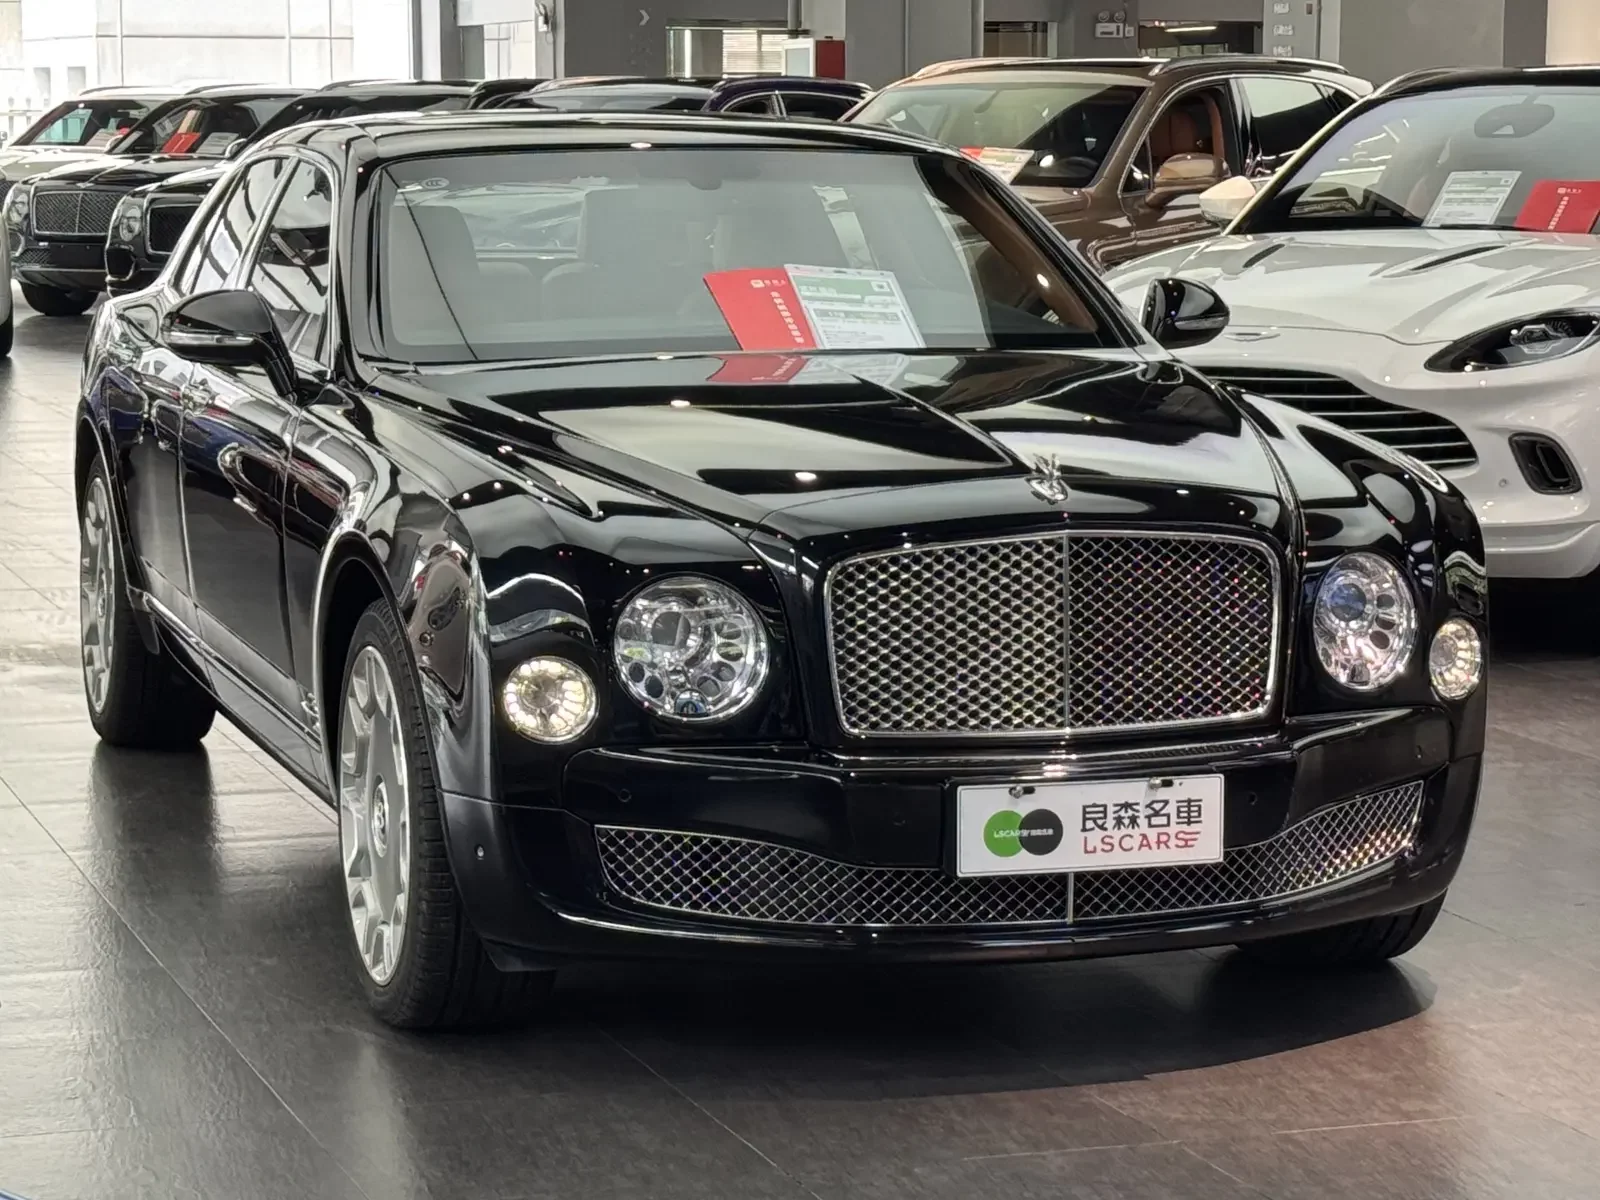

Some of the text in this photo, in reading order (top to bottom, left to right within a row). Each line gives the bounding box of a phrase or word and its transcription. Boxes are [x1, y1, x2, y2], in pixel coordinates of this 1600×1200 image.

[1080, 798, 1203, 833] 良森名車
[1083, 830, 1201, 855] LSCARS
